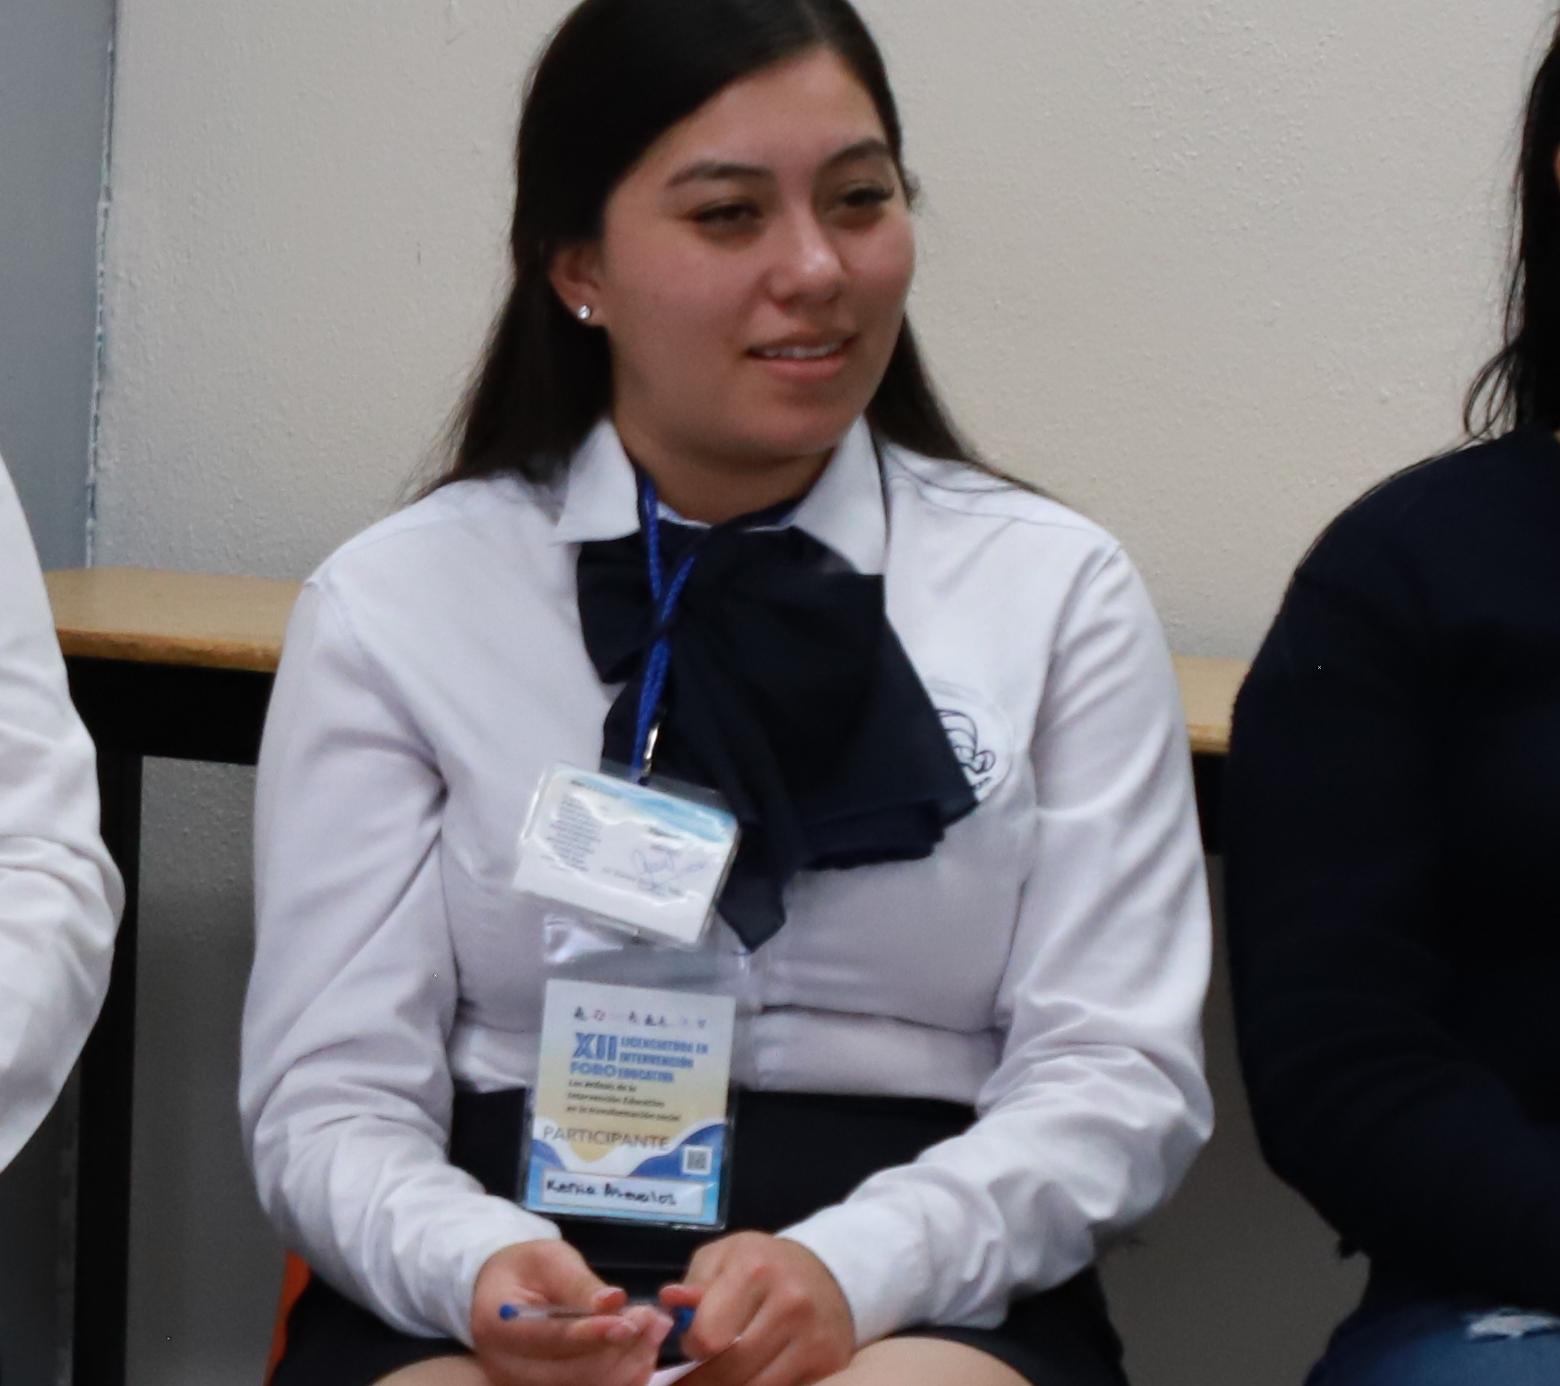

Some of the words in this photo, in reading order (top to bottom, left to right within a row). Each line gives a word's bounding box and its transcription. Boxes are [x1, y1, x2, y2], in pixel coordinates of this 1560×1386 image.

[572, 1032, 618, 1061] XII
[570, 1061, 617, 1076] FORO
[543, 1126, 670, 1150] PARTICIPANTE
